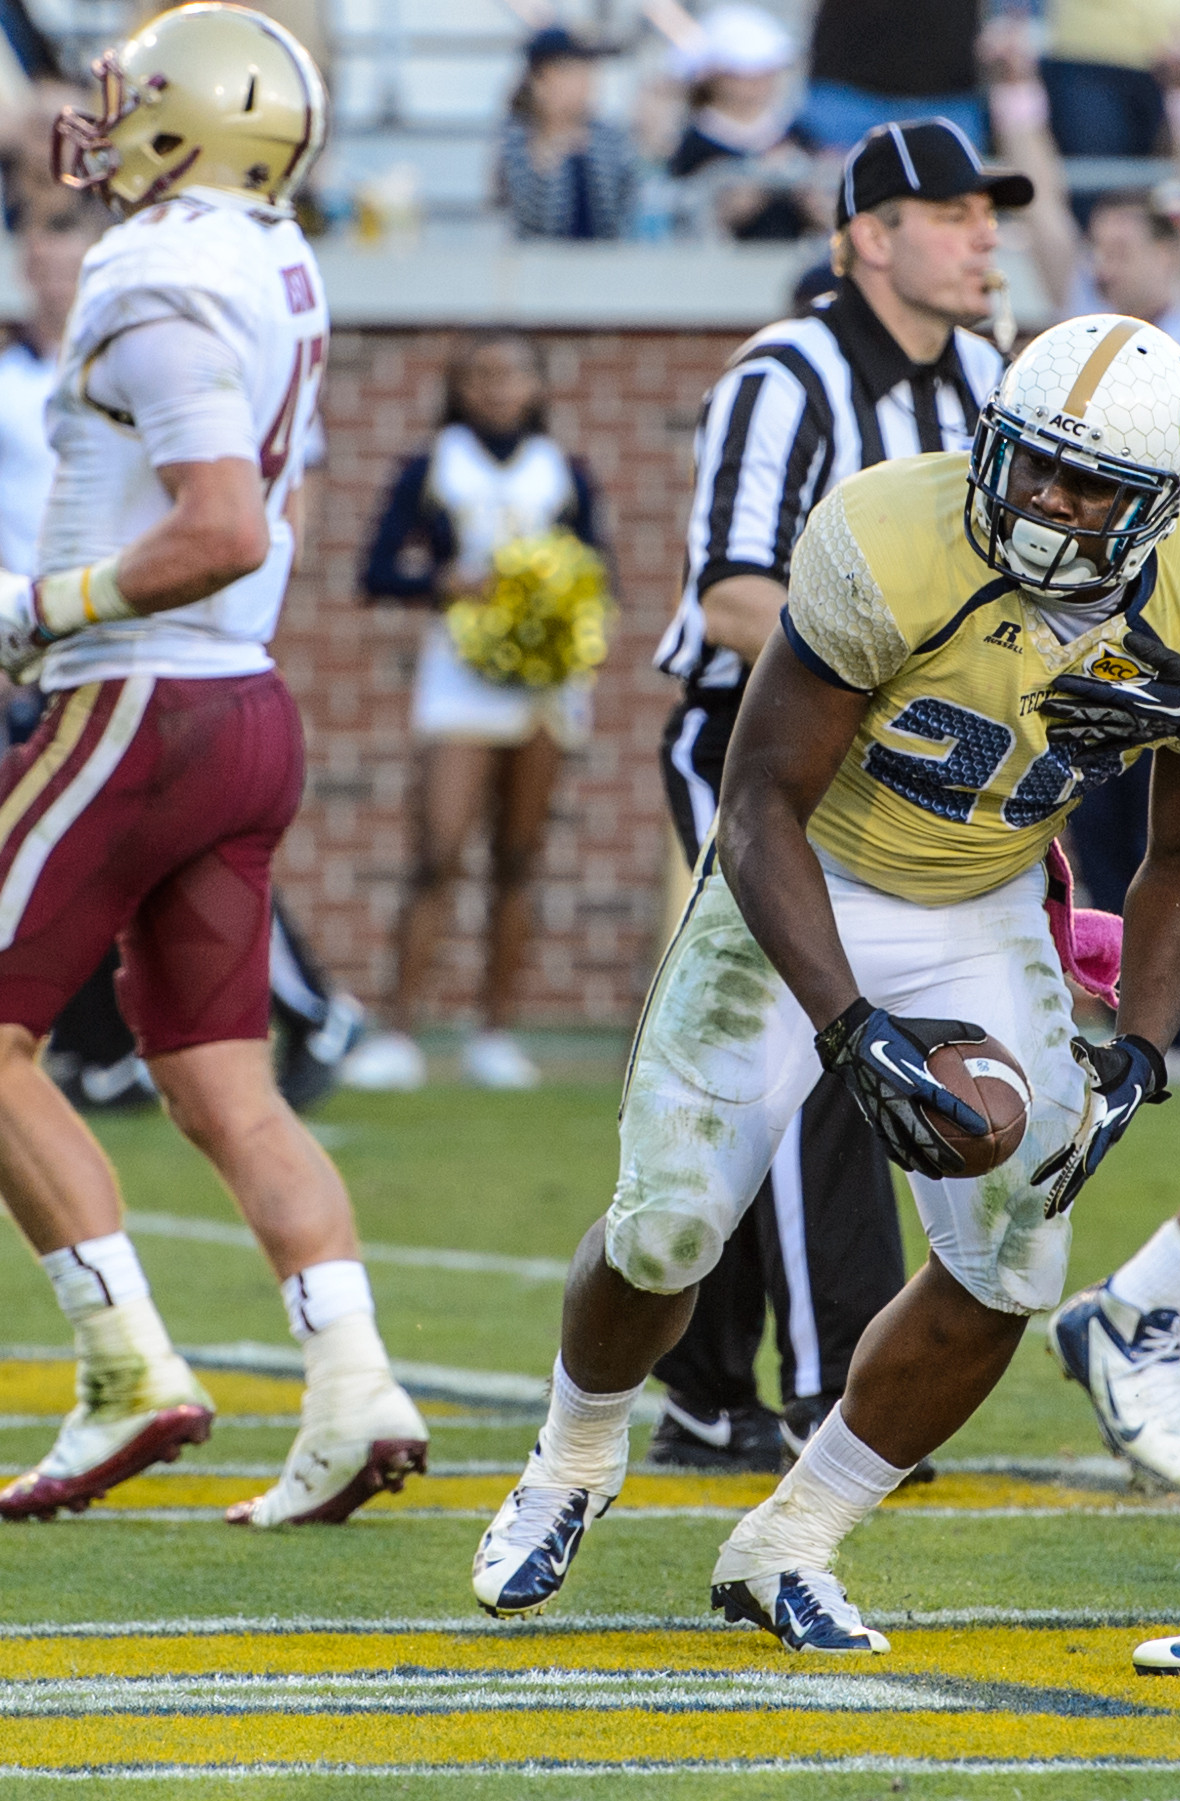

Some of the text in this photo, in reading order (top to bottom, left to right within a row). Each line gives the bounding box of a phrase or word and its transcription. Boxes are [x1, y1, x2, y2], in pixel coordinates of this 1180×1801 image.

[1049, 414, 1087, 437] ACC
[992, 620, 1022, 644] R
[983, 635, 1023, 654] RUSSELL
[1095, 660, 1133, 679] ACC
